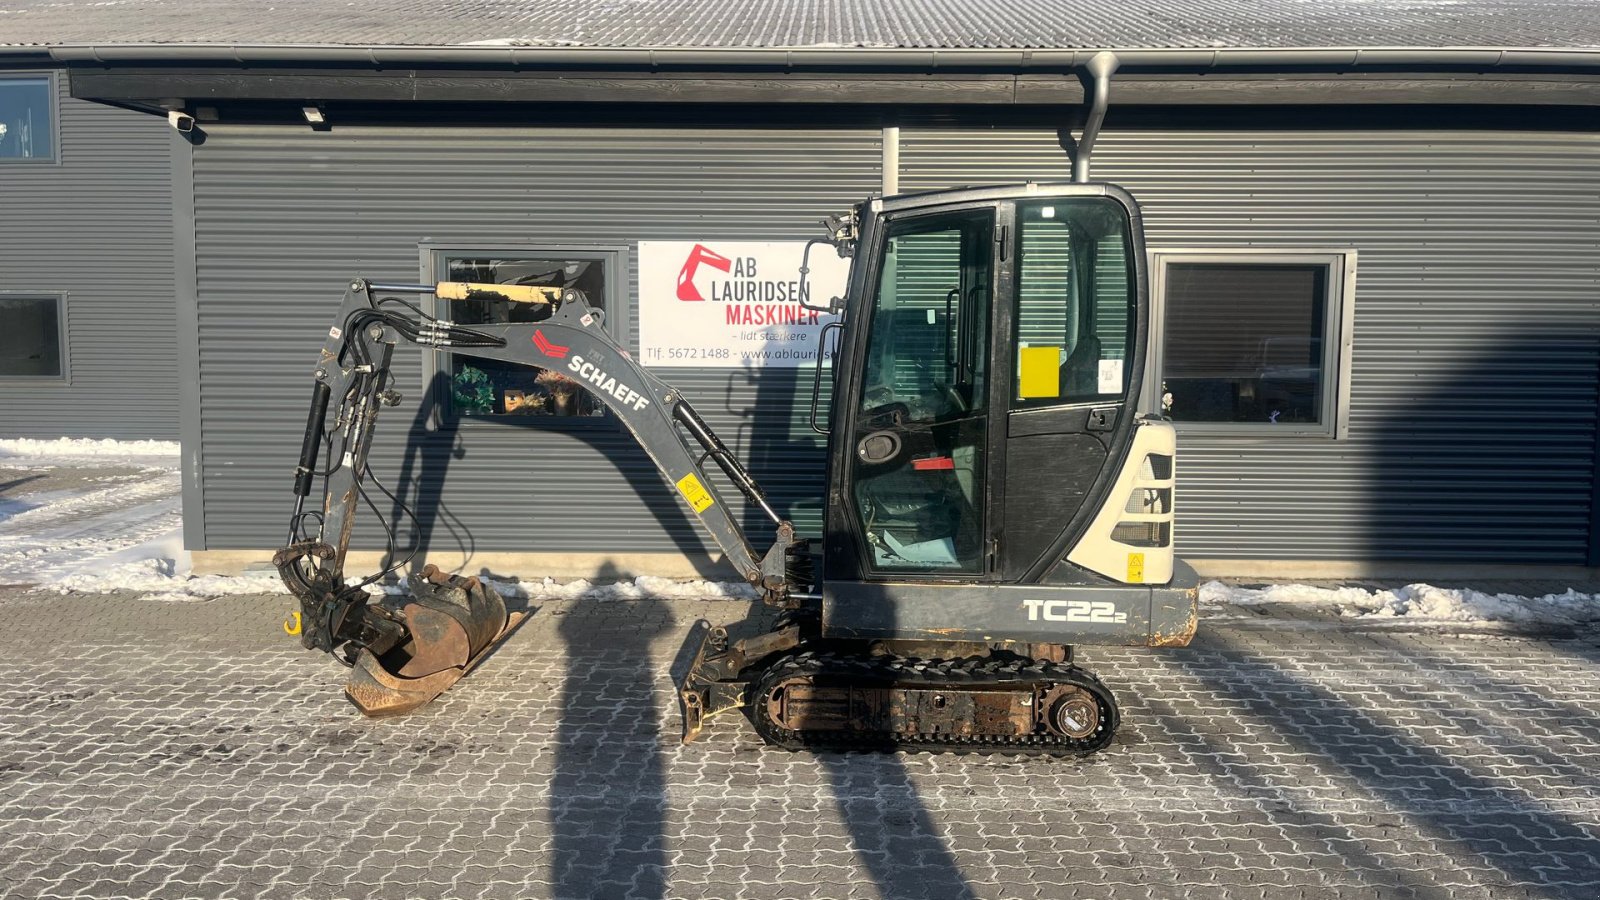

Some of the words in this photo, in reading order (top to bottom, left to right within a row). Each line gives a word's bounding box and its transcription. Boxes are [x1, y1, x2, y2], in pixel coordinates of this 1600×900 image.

[734, 257, 757, 277] AB
[712, 281, 810, 301] LAURIDSEN
[726, 305, 819, 325] MASKINER
[740, 331, 757, 341] lidt
[760, 331, 807, 341] stærkere
[646, 347, 665, 360] Tlf.
[668, 348, 697, 358] 5672
[701, 348, 730, 359] 1488
[567, 355, 650, 411] SCHAEFF
